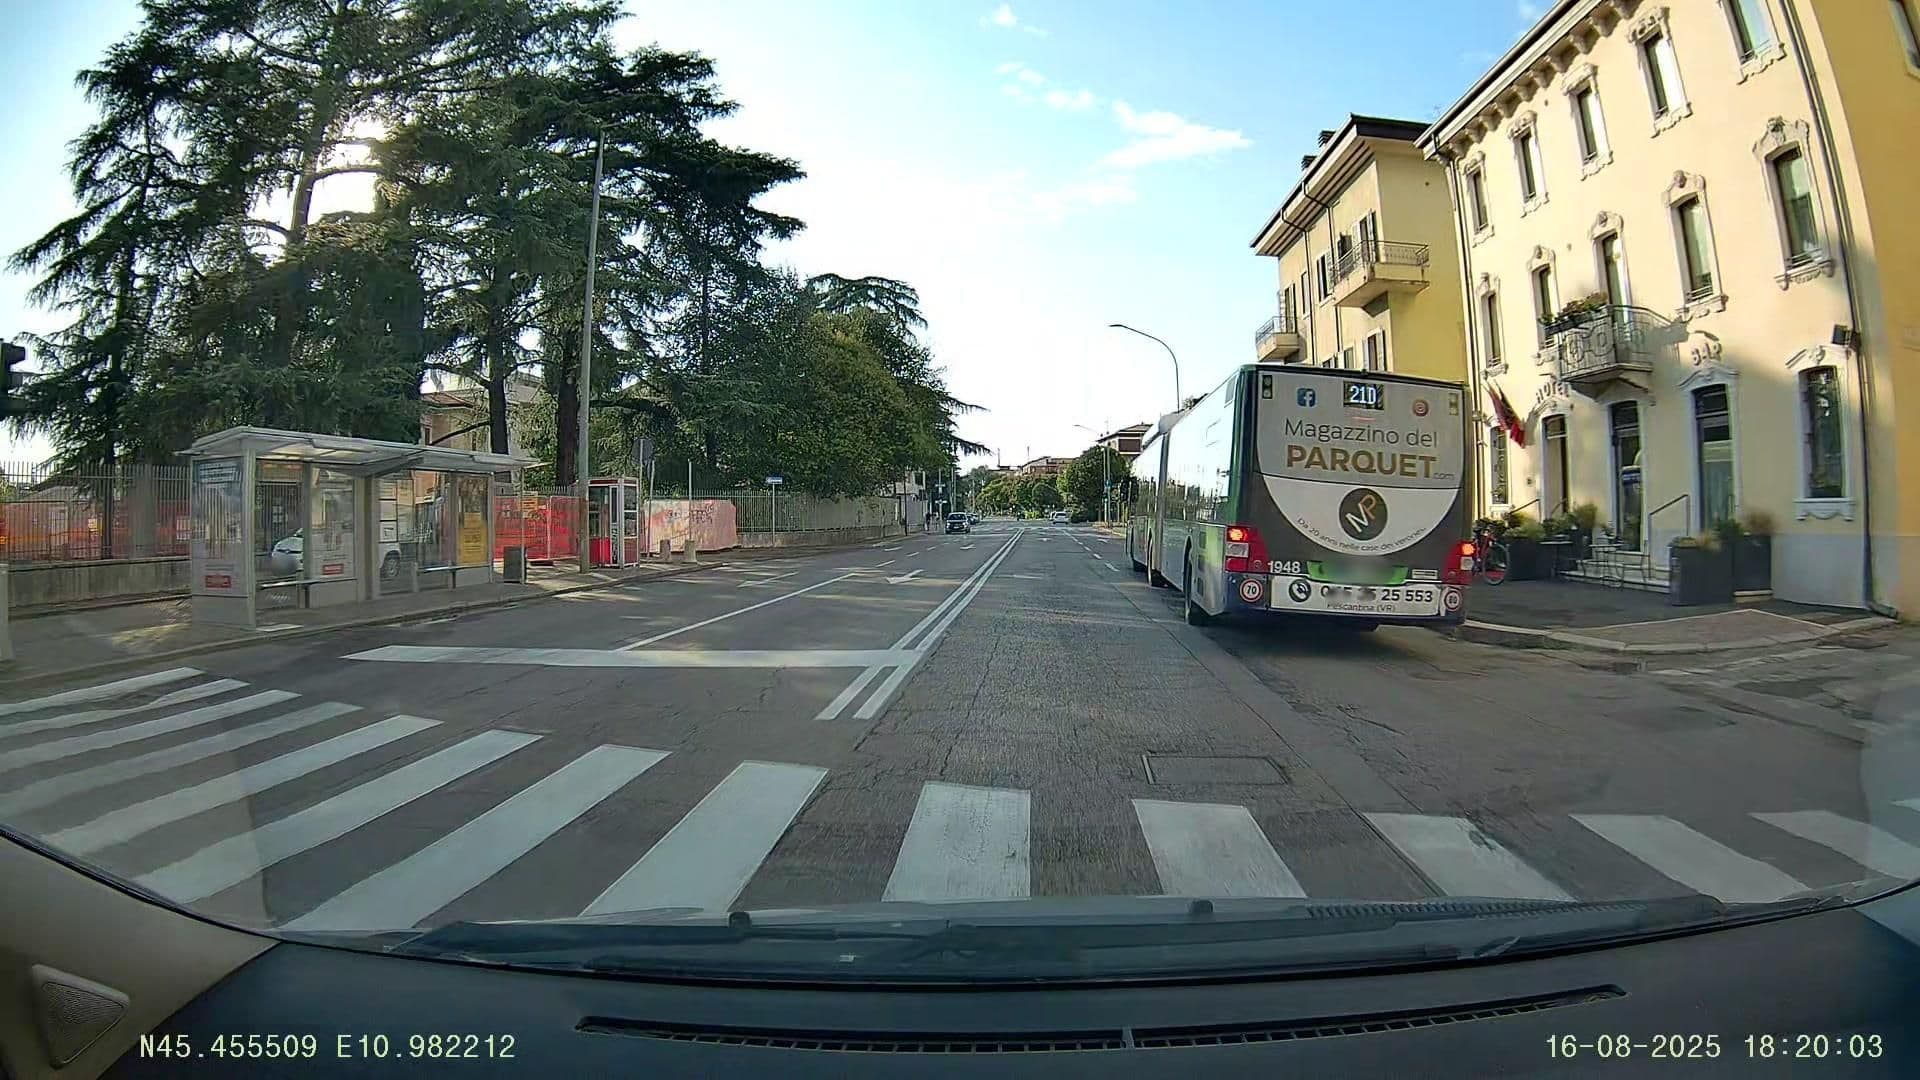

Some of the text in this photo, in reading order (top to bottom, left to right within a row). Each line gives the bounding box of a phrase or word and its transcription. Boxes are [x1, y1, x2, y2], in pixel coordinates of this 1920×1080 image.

[1285, 418, 1438, 449] Magazzino del
[1287, 445, 1437, 479] PARQUET
[1267, 560, 1301, 574] 1948
[1247, 585, 1257, 595] 70
[1380, 588, 1401, 602] 25
[1404, 589, 1433, 602] 553
